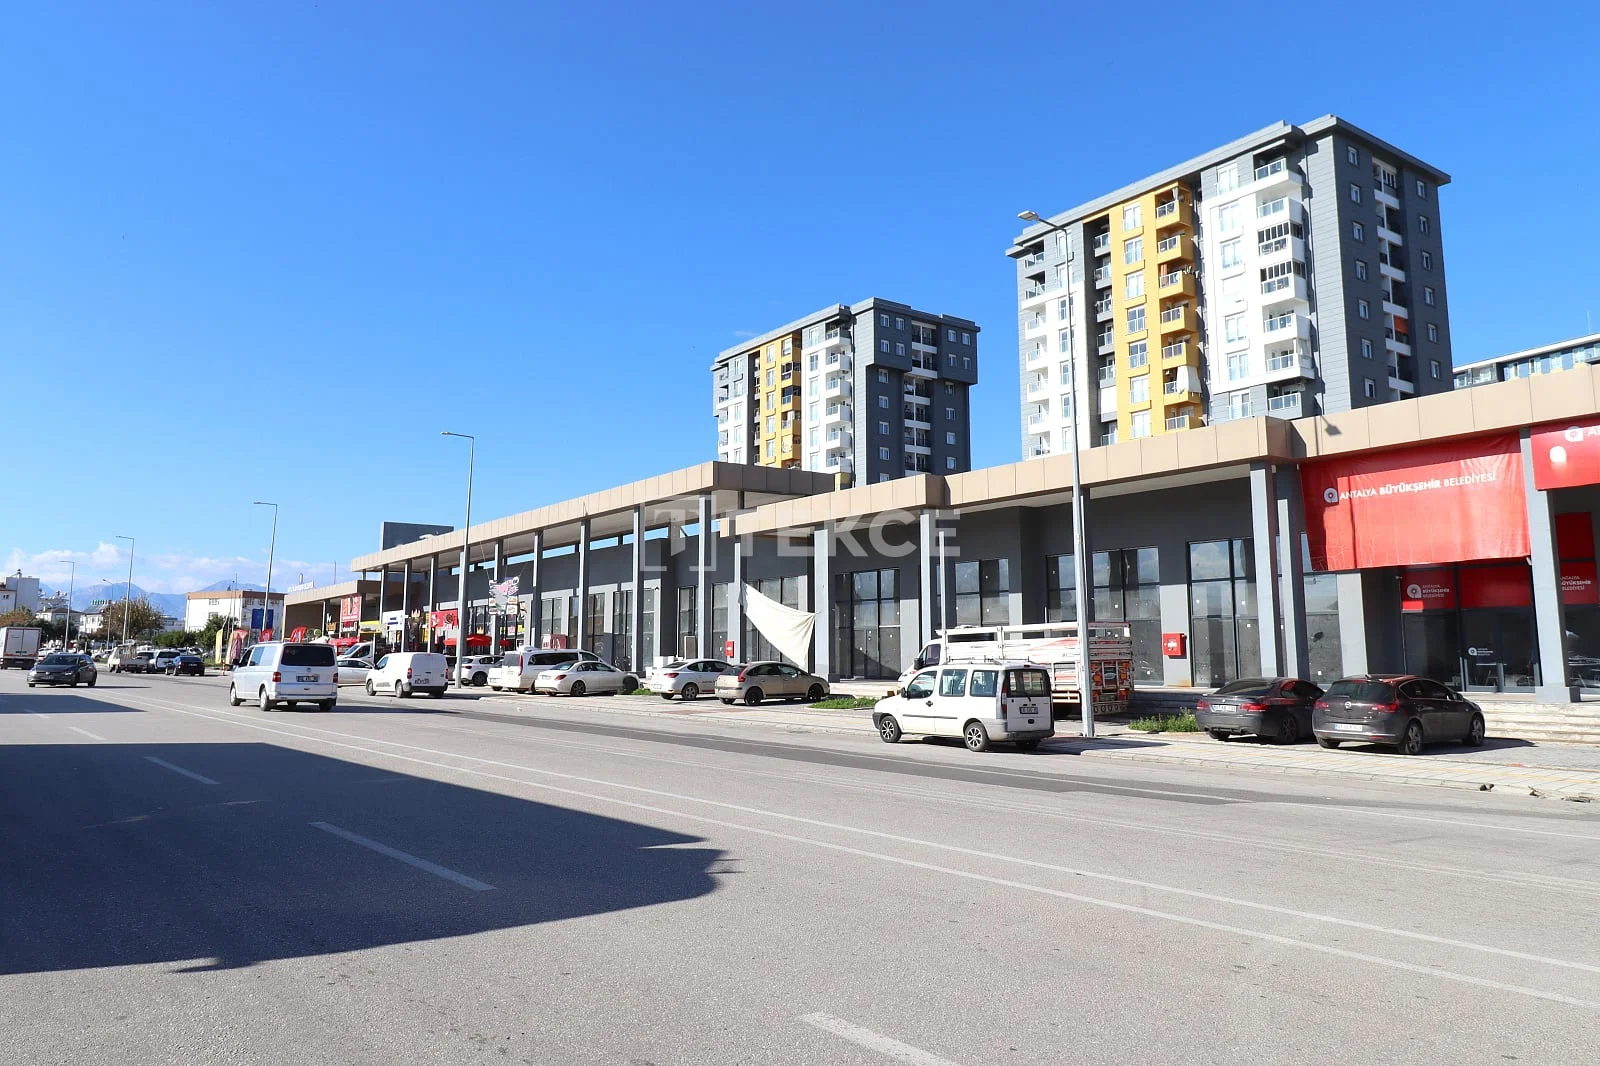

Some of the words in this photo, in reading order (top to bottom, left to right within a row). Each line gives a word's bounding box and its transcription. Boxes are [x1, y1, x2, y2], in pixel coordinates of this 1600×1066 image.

[1339, 487, 1377, 500] ANTALYA
[1379, 478, 1441, 495] BÜYÜKŞEHİR
[1443, 472, 1496, 487] BELEDİYESİ
